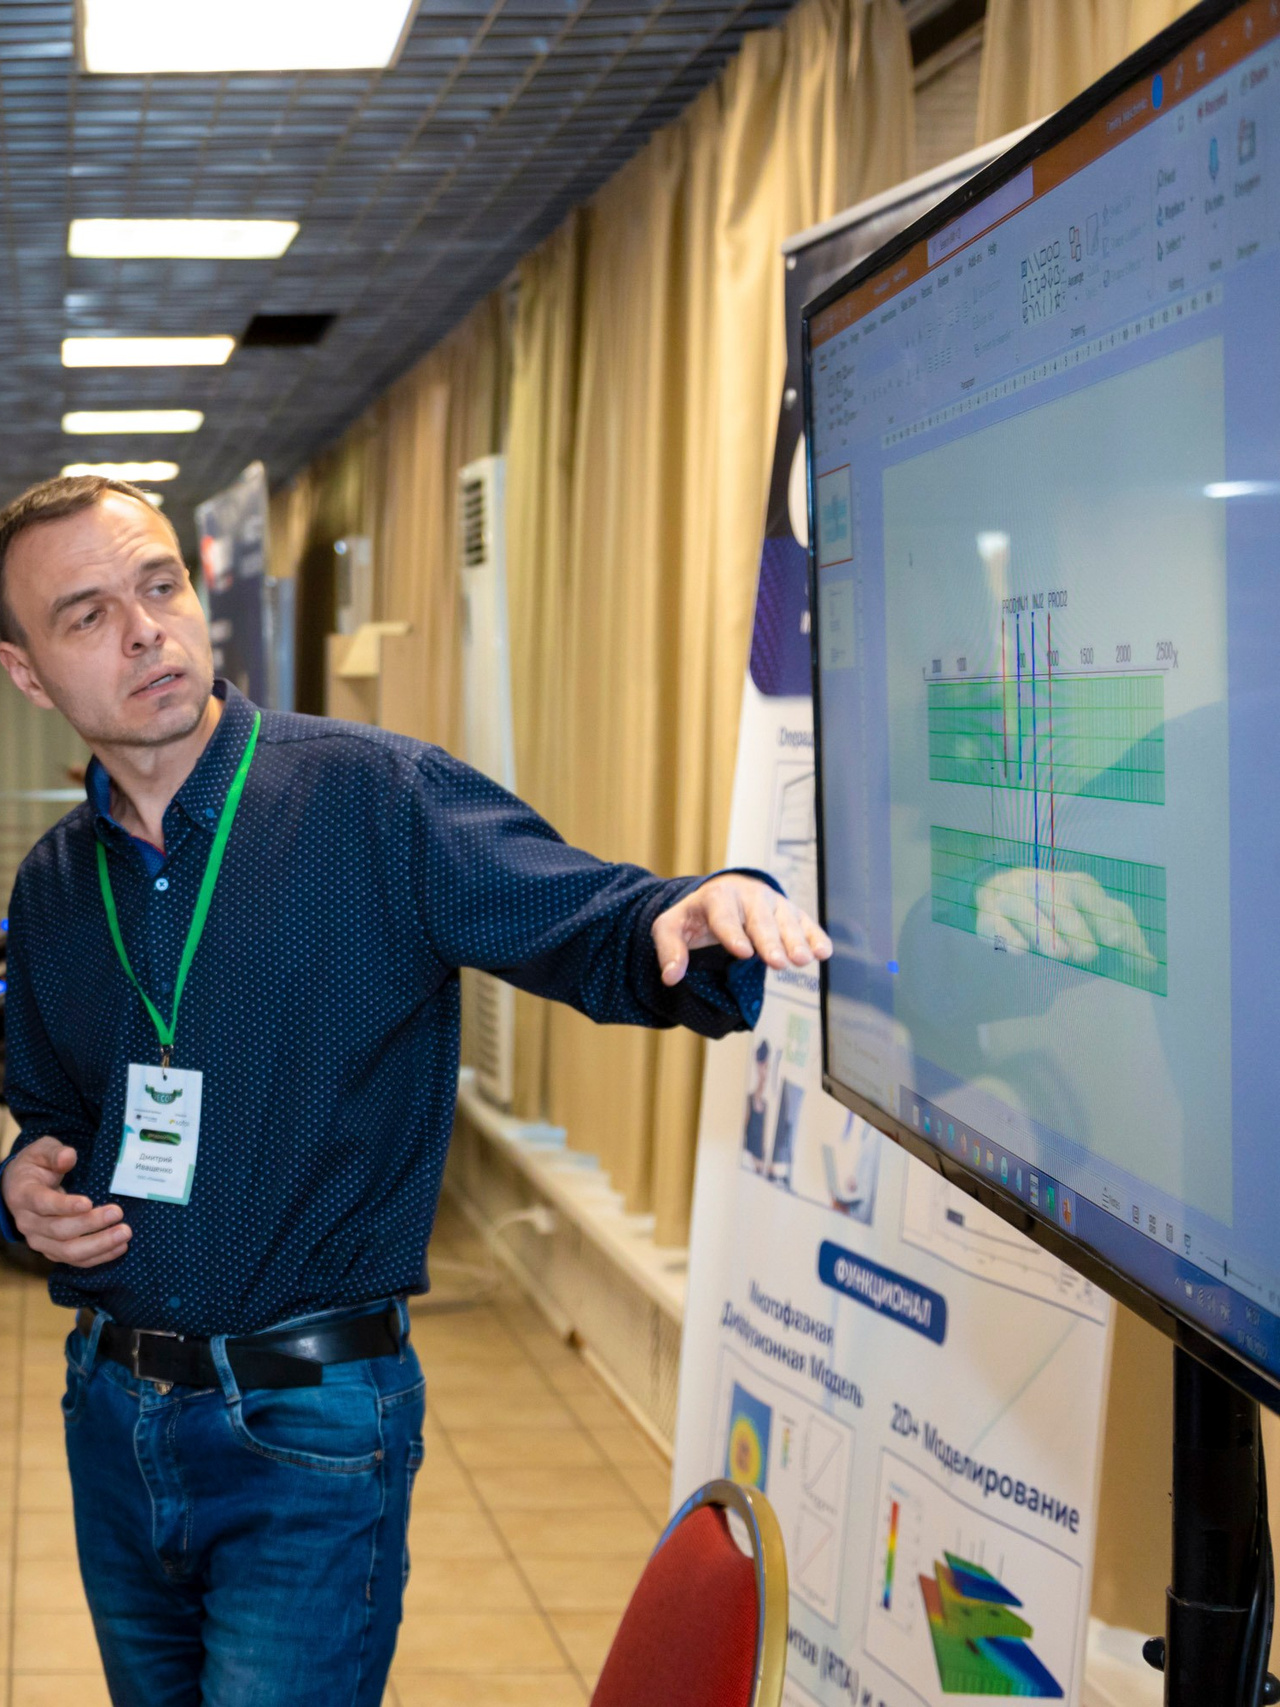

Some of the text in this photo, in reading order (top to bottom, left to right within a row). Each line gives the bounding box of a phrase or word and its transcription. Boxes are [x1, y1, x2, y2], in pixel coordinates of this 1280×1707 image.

[1048, 590, 1068, 608] PROD2
[1080, 647, 1094, 665] 1500
[1115, 644, 1131, 663] 2000
[1156, 641, 1173, 661] 2500
[833, 1256, 932, 1329] ФУНКЦИОНАЛ
[810, 1354, 864, 1409] Модель
[891, 1402, 1080, 1534] 2D+ Моделирование
